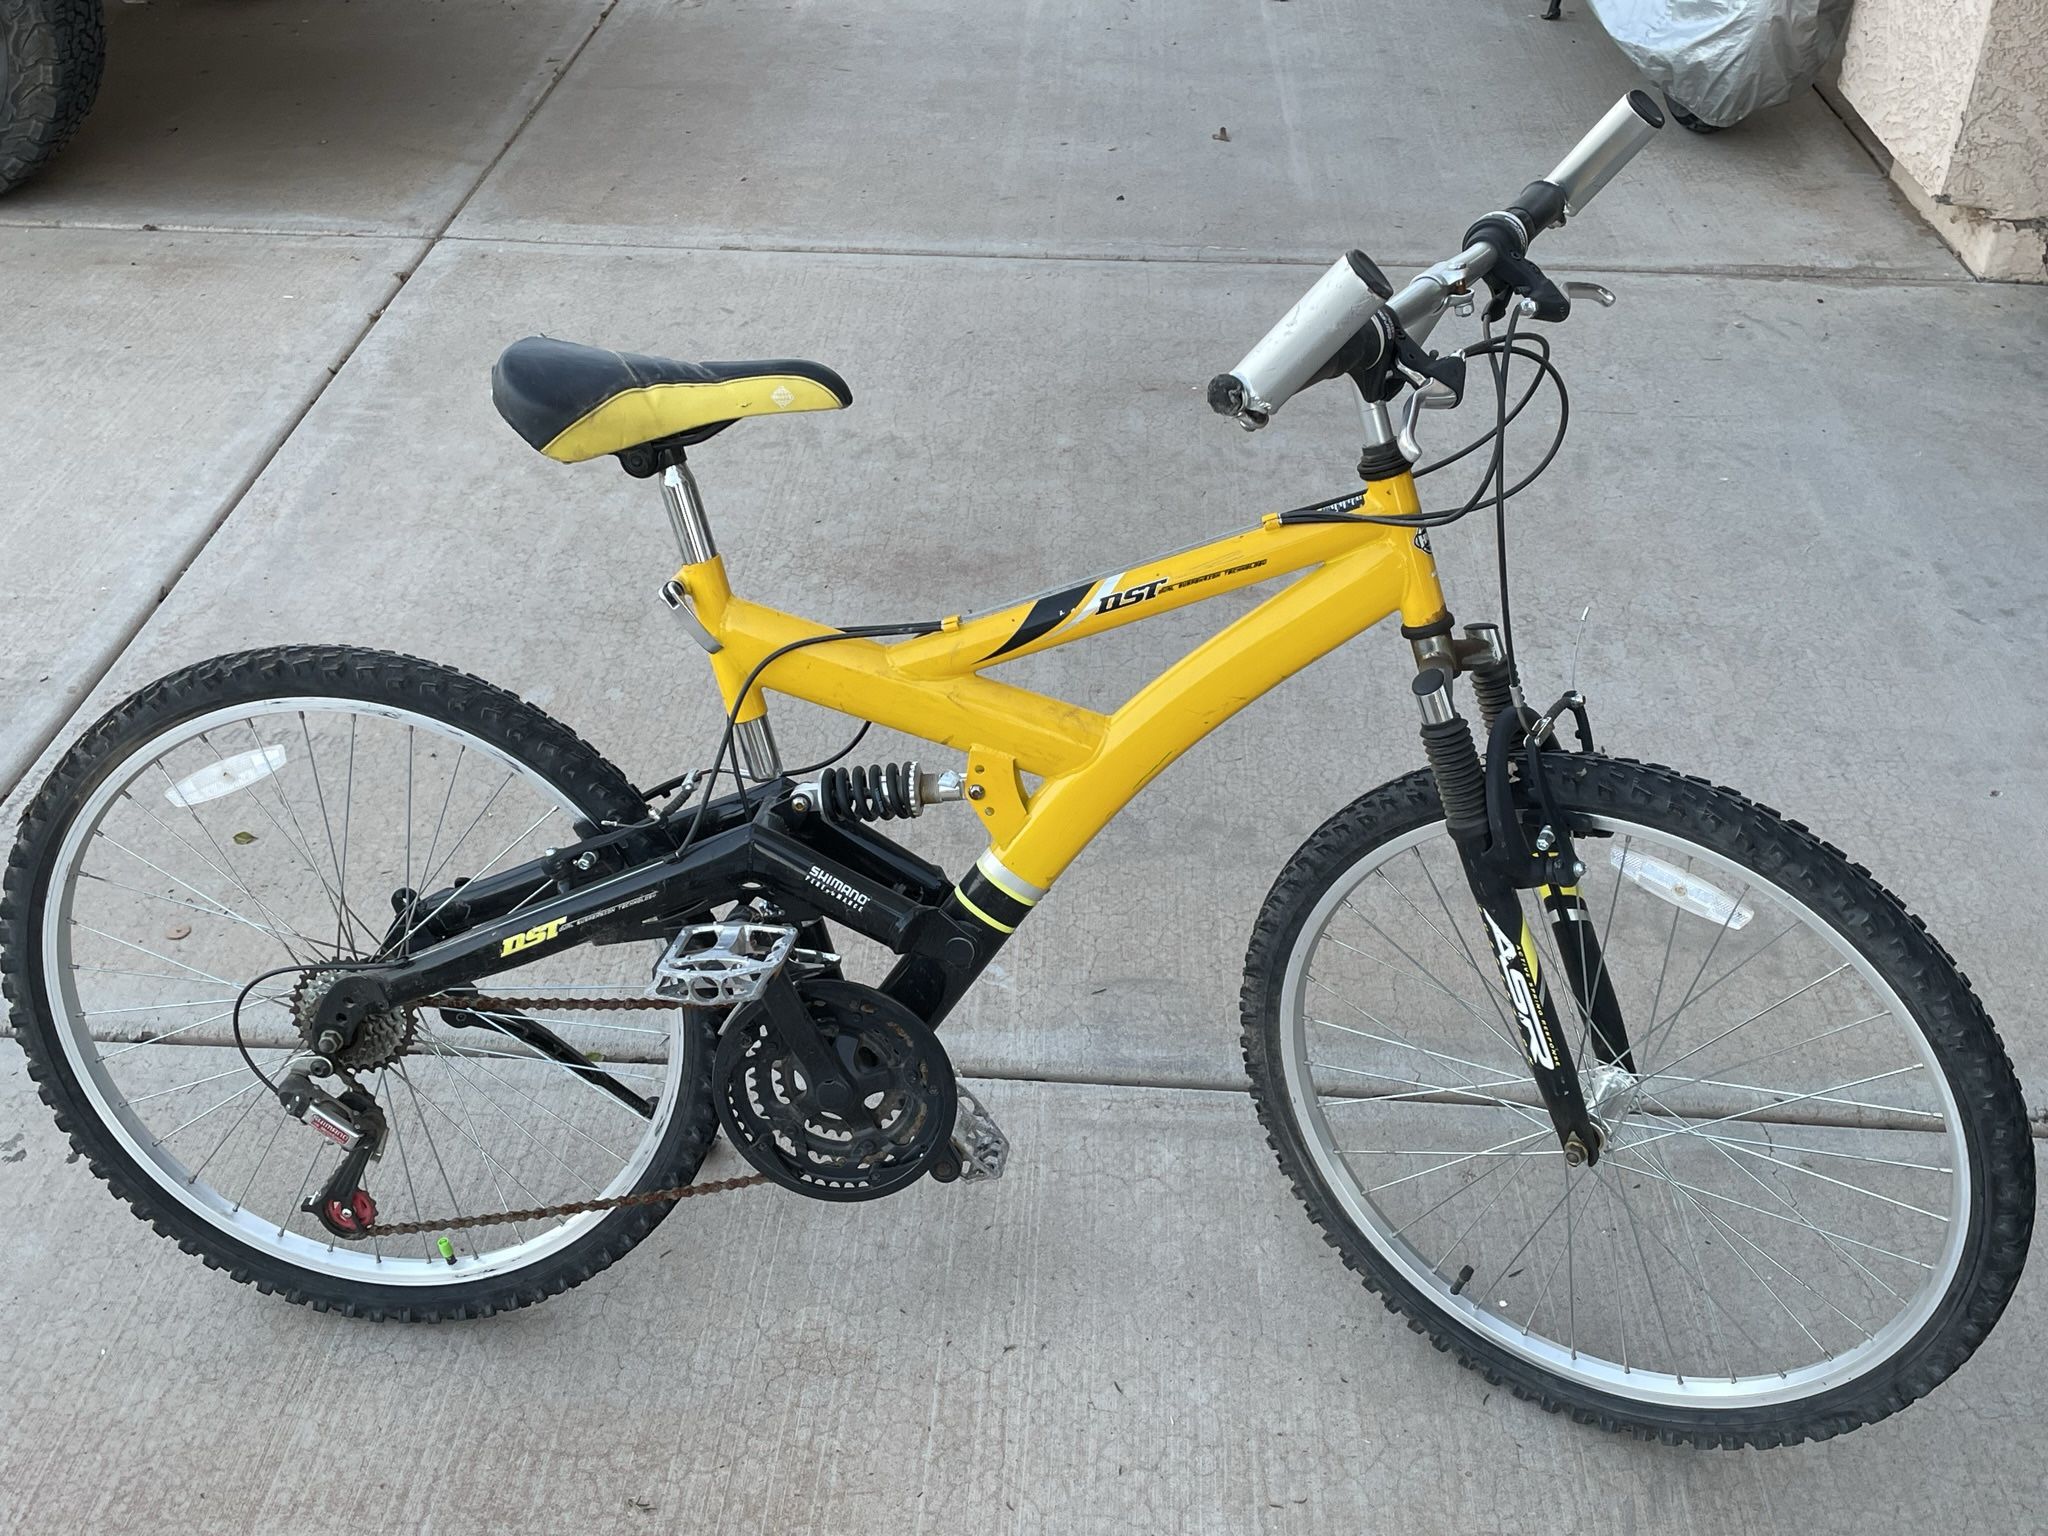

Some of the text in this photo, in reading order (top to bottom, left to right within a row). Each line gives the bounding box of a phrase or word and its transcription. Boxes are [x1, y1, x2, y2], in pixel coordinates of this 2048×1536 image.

[1095, 578, 1168, 615] DST
[808, 865, 869, 905] SHIMANO
[500, 916, 568, 958] DST
[1516, 944, 1561, 1067] ACTIVE SPRING RESPONSE
[313, 1114, 349, 1141] SHIMANO
